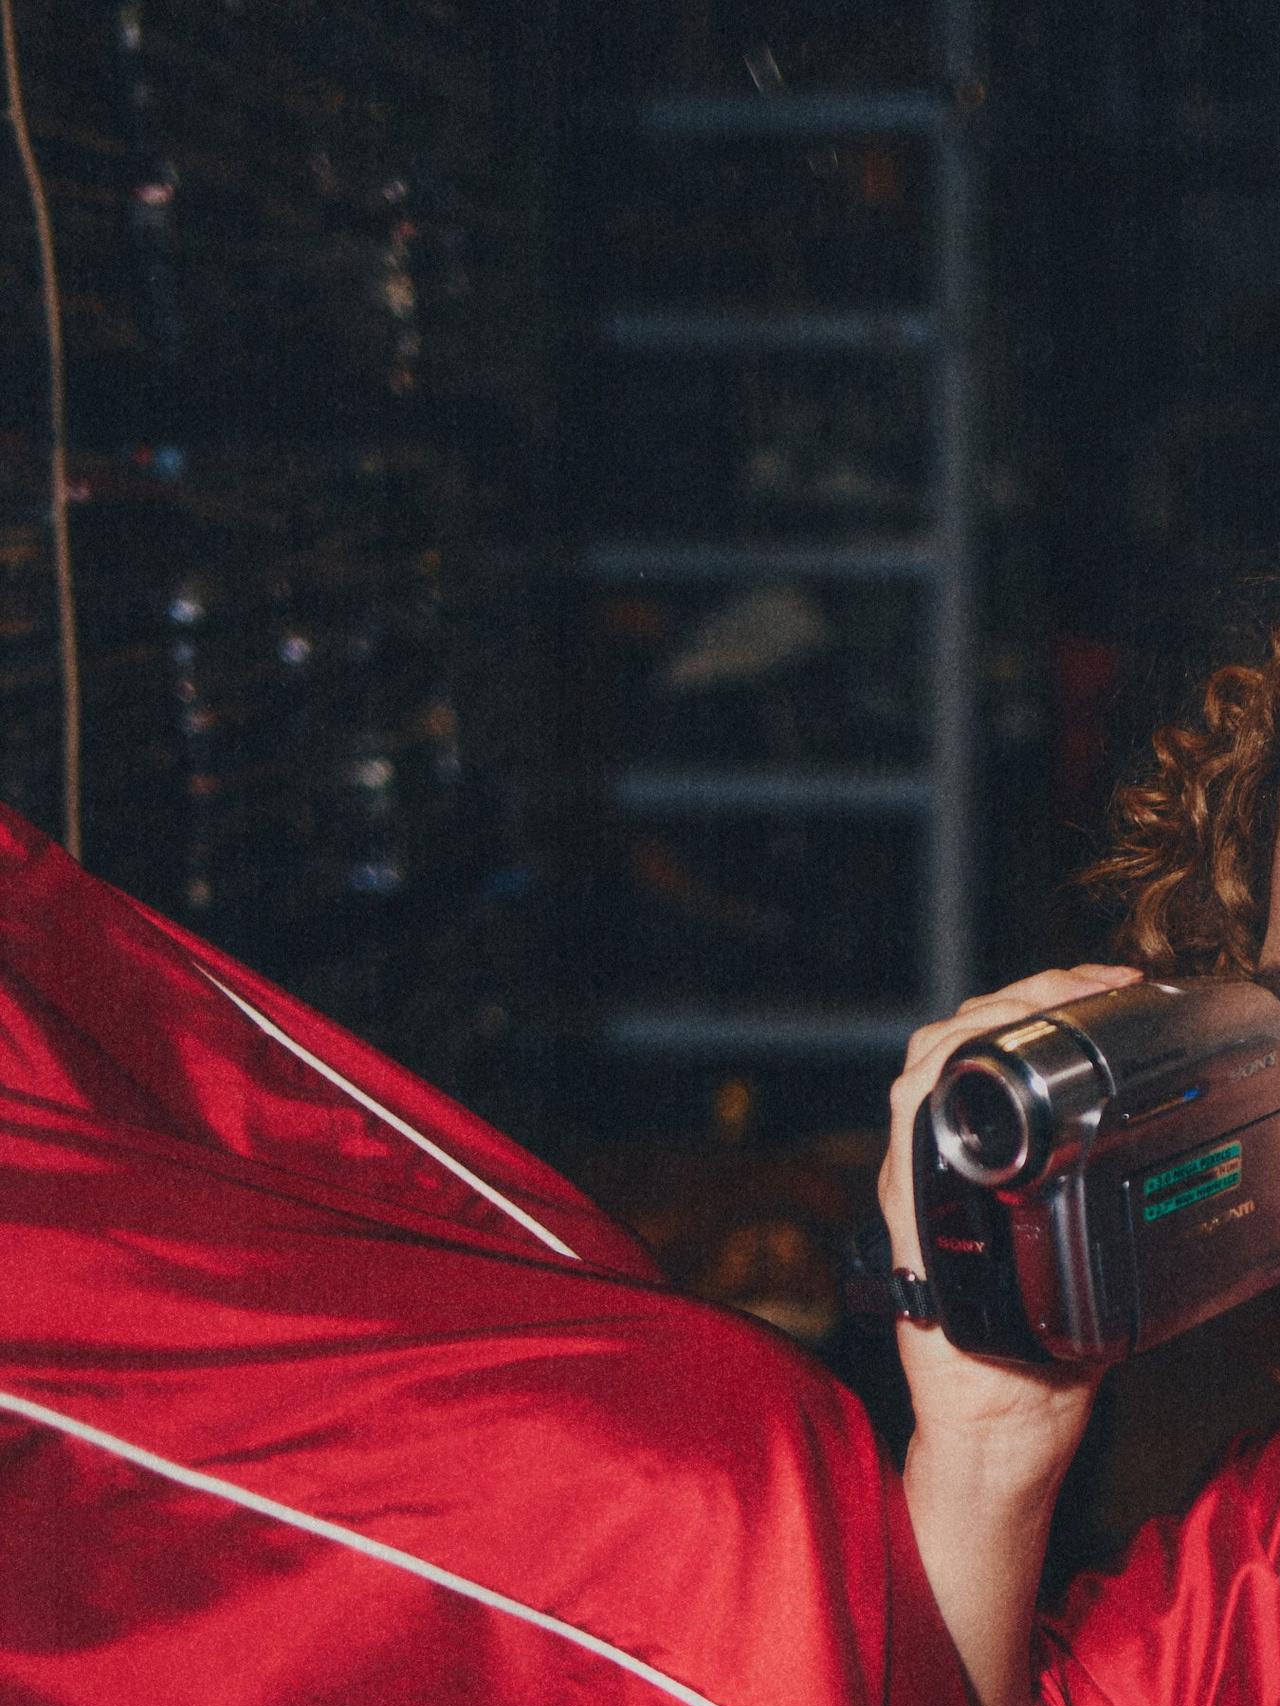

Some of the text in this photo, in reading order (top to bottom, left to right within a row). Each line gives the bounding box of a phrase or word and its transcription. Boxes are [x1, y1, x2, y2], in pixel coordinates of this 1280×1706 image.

[1227, 1050, 1278, 1084] SONY
[1200, 1147, 1232, 1169] PIXELS
[1223, 1172, 1239, 1186] LCD
[936, 1236, 985, 1253] SONY
